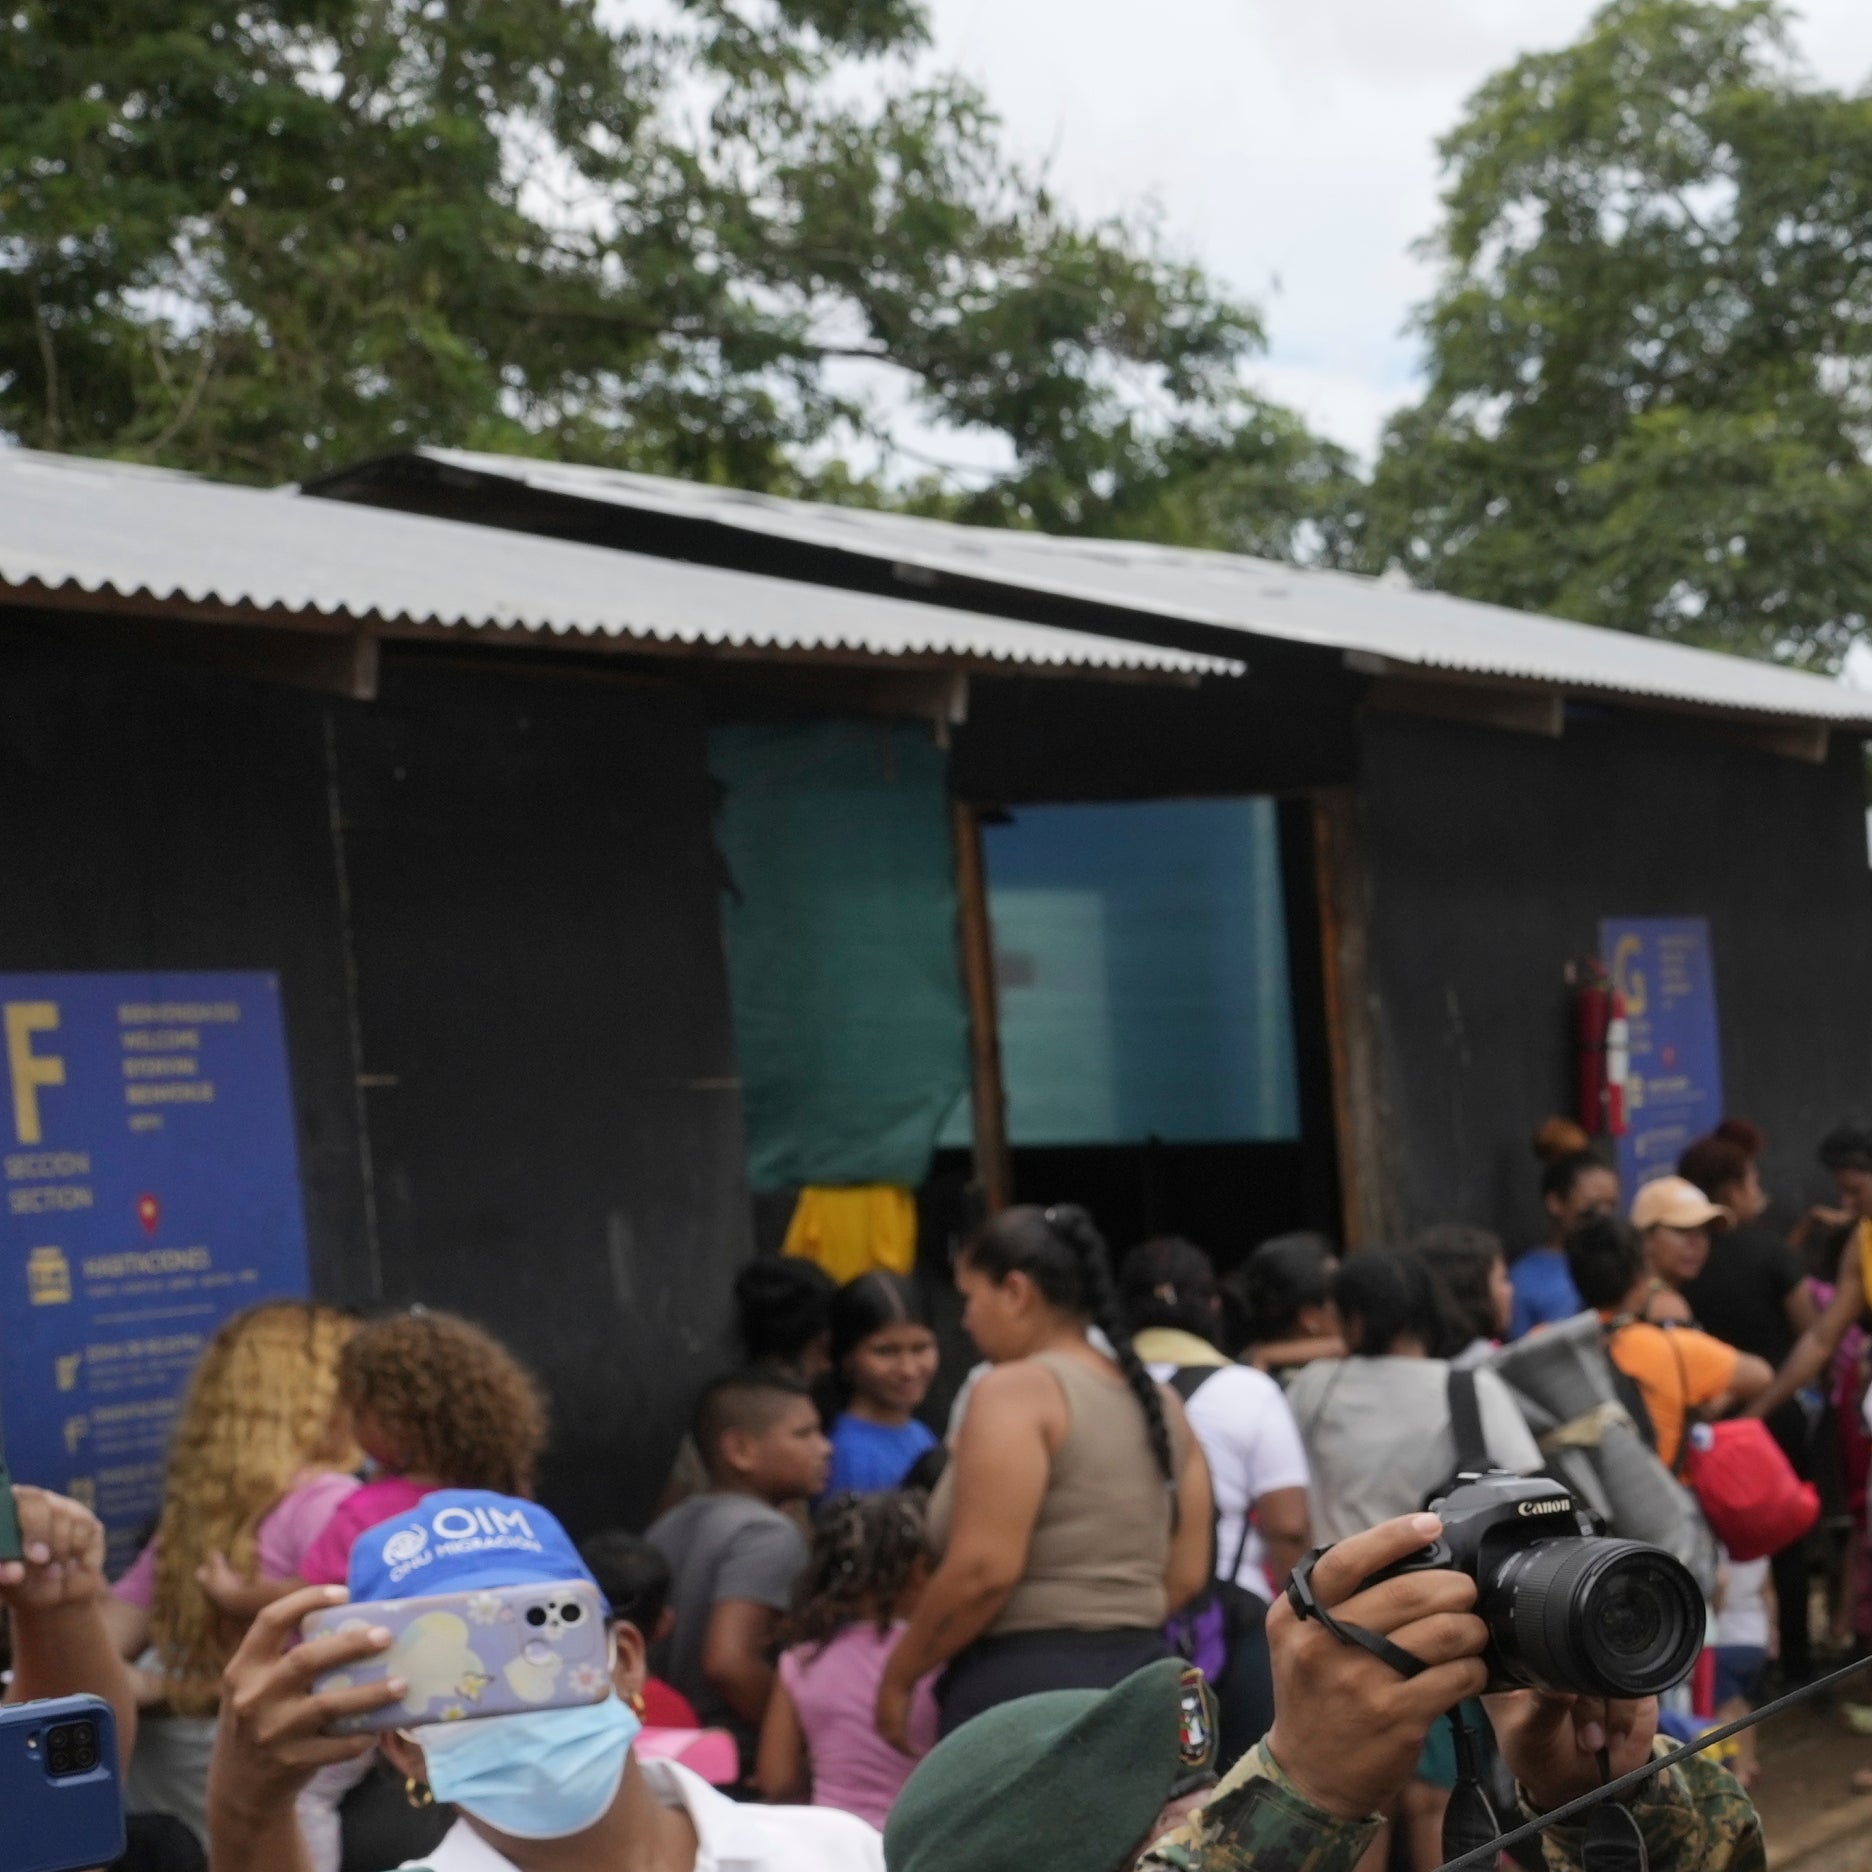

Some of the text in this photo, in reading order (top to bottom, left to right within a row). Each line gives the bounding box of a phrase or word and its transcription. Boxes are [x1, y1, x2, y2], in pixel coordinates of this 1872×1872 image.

[5, 1002, 65, 1145] F
[432, 1507, 534, 1539] OIM
[1518, 1499, 1570, 1517] Canon
